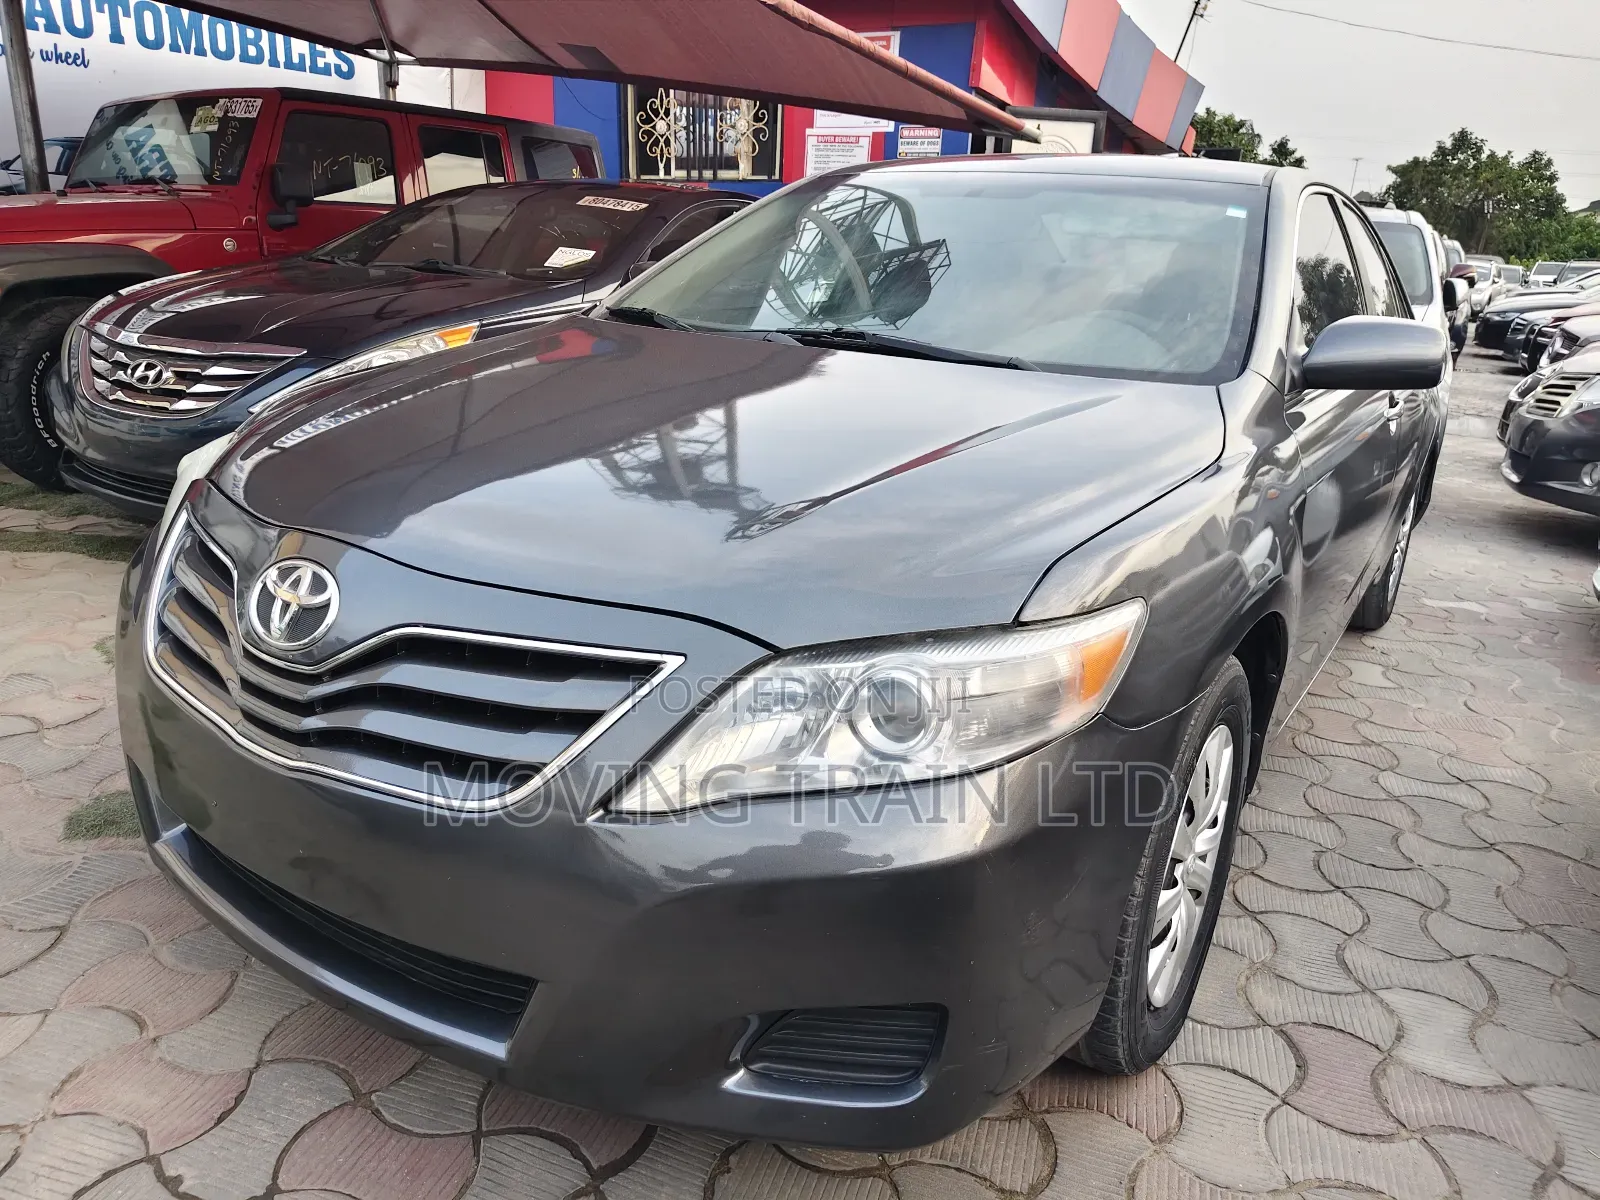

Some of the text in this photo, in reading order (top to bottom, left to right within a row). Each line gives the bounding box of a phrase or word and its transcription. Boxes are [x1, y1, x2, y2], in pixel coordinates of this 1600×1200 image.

[25, 0, 356, 81] AUTOMOBILES
[40, 43, 90, 68] wheel
[902, 129, 939, 137] WARNING
[30, 351, 58, 448] BFGoodrich
